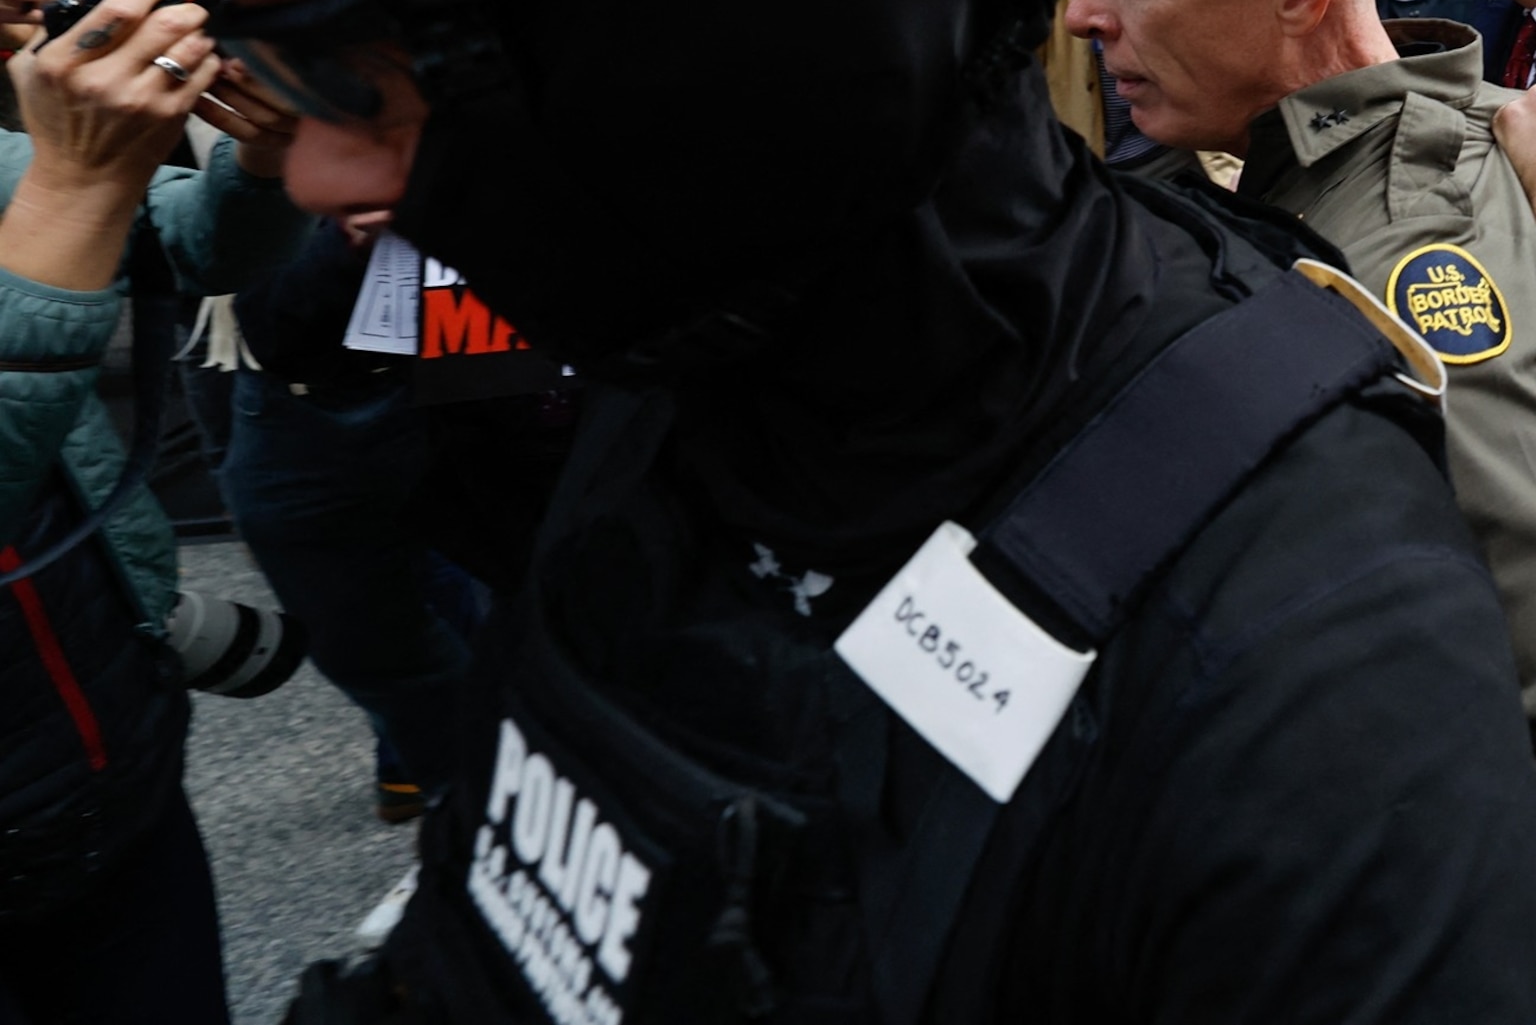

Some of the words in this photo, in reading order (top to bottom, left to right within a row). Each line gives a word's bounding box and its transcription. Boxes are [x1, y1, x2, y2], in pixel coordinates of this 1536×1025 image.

[1427, 264, 1466, 283] U.S.
[1412, 285, 1491, 313] BORDER
[1418, 306, 1500, 334] PATROL
[487, 717, 652, 982] POLICE
